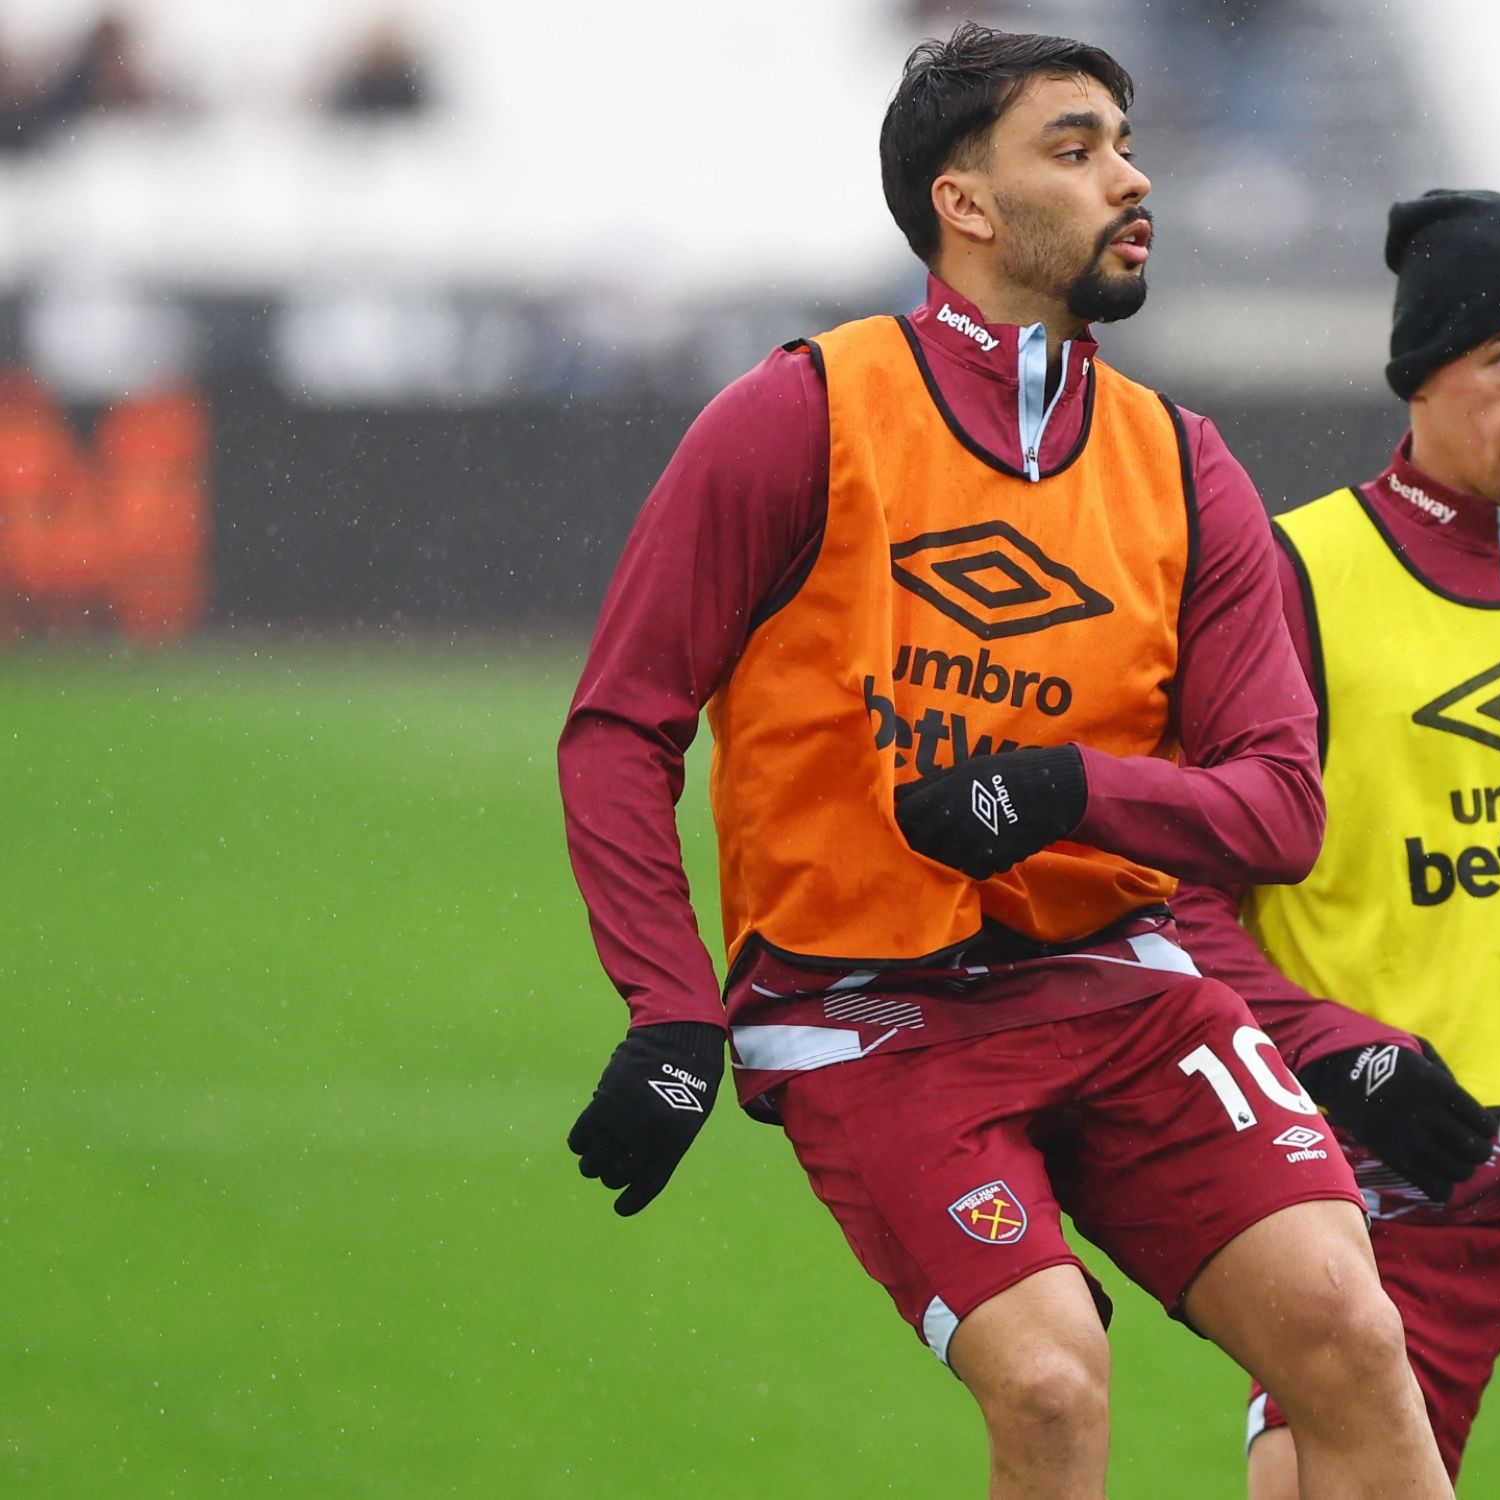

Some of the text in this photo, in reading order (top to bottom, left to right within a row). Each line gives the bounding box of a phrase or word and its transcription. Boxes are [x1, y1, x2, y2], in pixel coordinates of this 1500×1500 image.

[936, 303, 1000, 351] betway
[1388, 473, 1457, 524] betway
[991, 773, 1019, 825] umbro
[661, 1063, 708, 1093] umbro
[1178, 1025, 1319, 1132] 10
[1285, 1148, 1328, 1164] umbro
